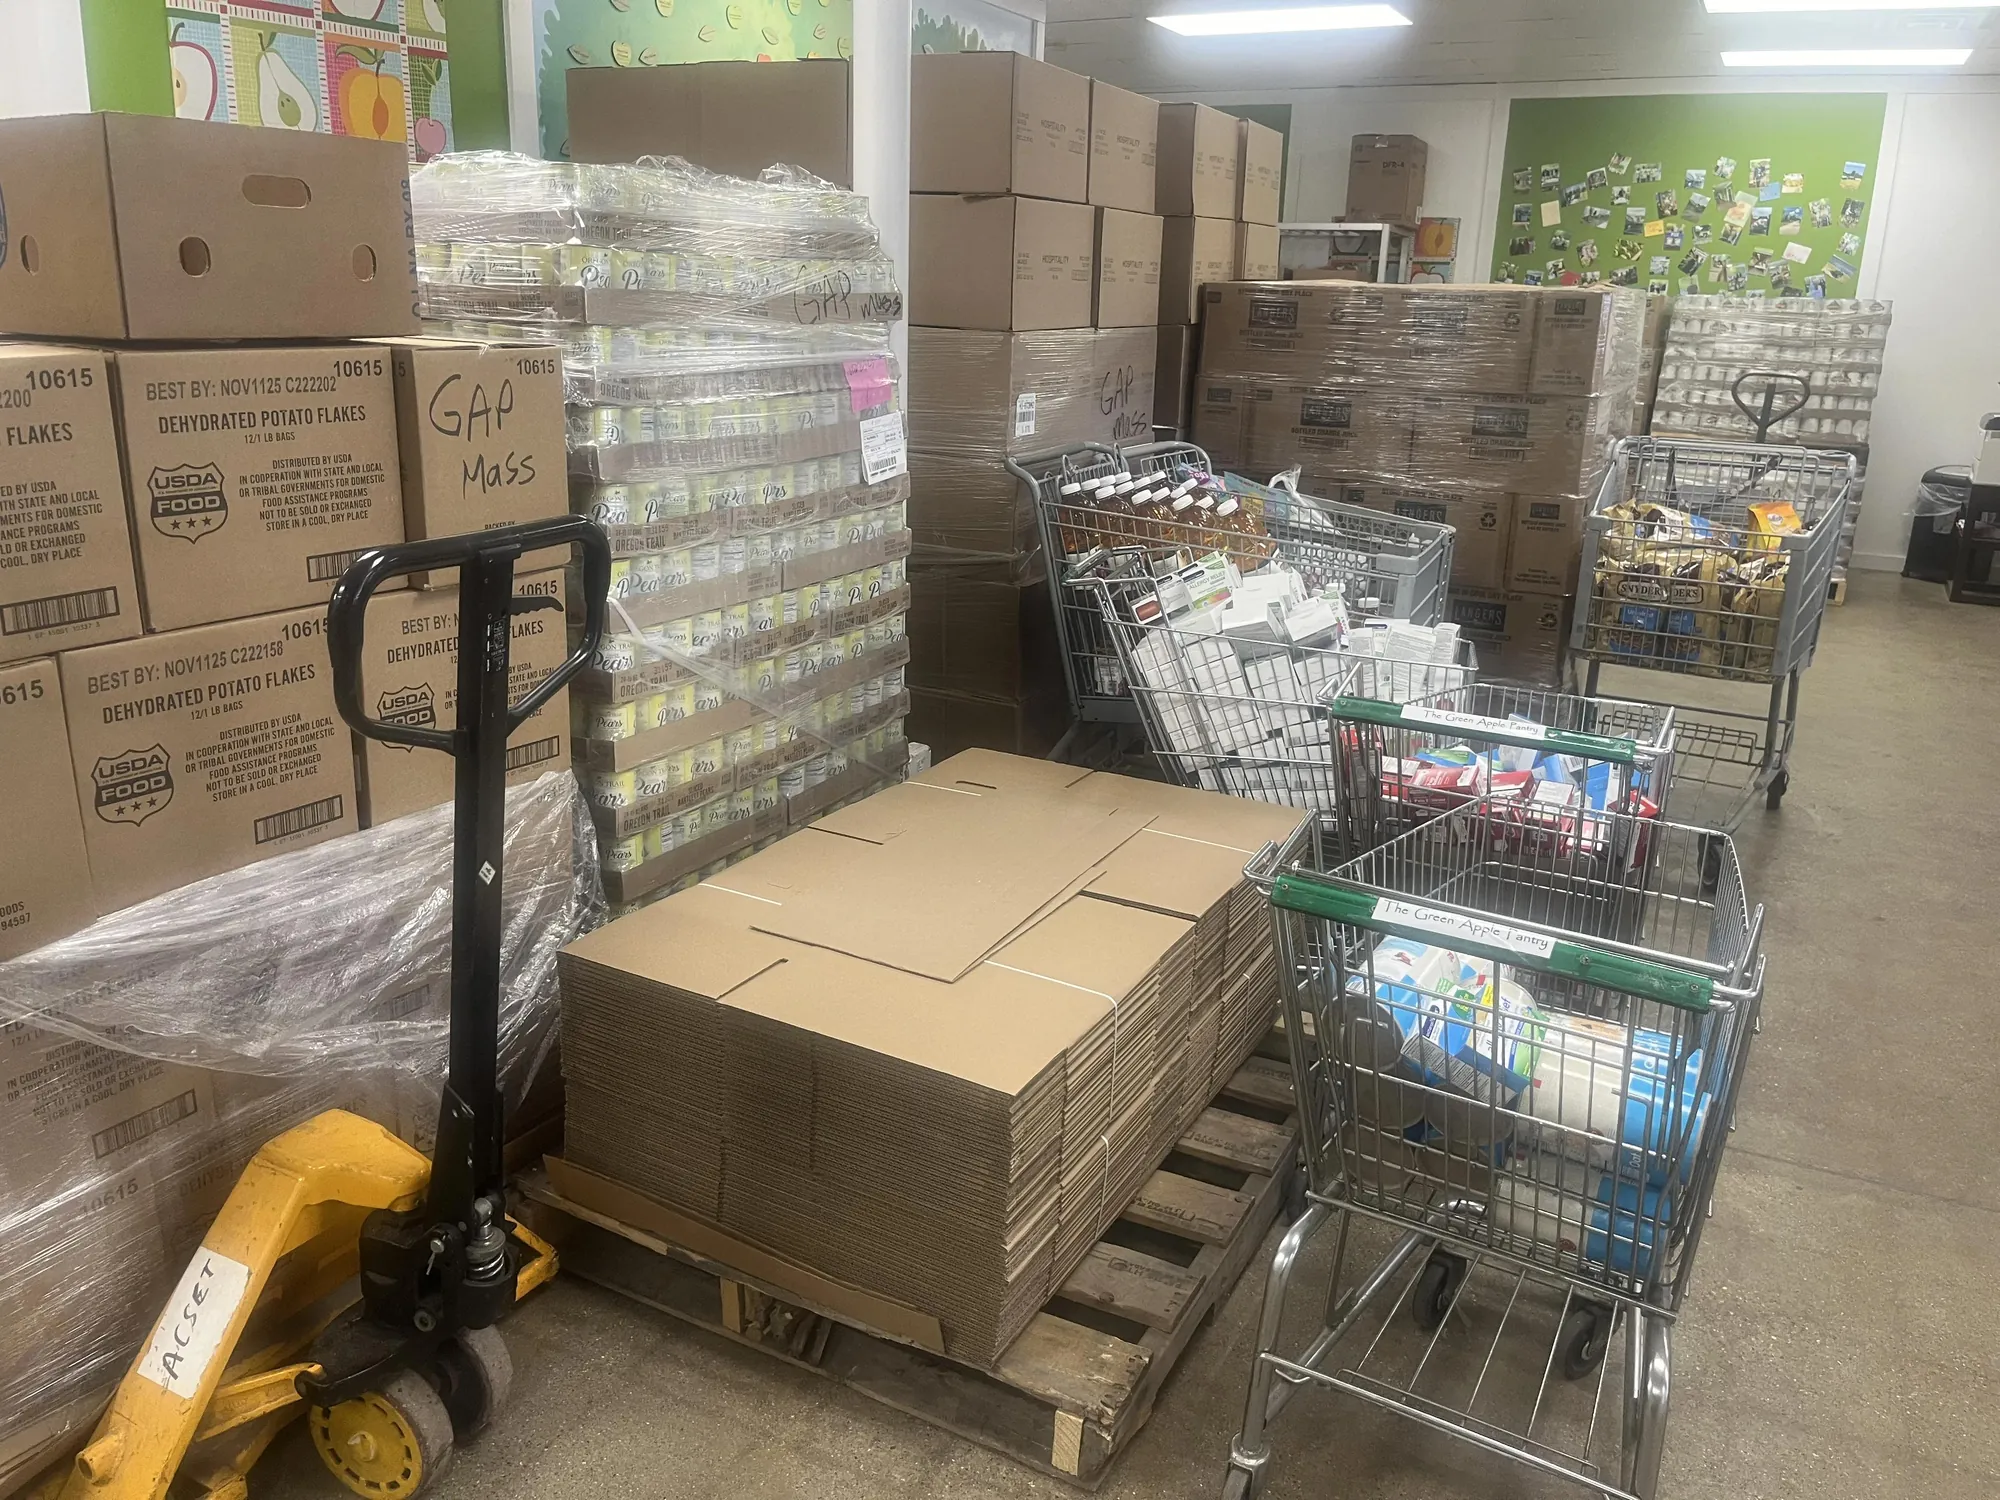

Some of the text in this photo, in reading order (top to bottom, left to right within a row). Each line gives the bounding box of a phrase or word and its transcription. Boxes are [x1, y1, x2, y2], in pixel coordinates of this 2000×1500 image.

[794, 264, 851, 324] GAP
[334, 360, 382, 378] 10615
[516, 359, 554, 375] 10615
[26, 368, 93, 390] 10615
[146, 376, 336, 400] BEST BY: NOV1125 C222202
[0, 389, 31, 408] 200
[1101, 365, 1134, 416] GAP
[429, 374, 514, 442] GAP
[158, 405, 366, 434] DEHYDRATED POTATO FLAKES
[6, 422, 73, 446] FLAKES
[244, 432, 296, 444] 12/1 LB BAGS
[272, 454, 352, 470] DISTRIBUTED BY USDA
[154, 472, 218, 490] USDA
[240, 462, 384, 484] IN COOPERATION WITH STATE AND LOCAL
[16, 484, 28, 494] BY
[31, 481, 57, 493] USDA
[239, 474, 385, 498] OR TRIBAL GOVERNMENTS FOR DOMESTIC
[18, 496, 46, 510] STATE
[50, 493, 68, 504] AND
[72, 490, 100, 502] LOCAL
[157, 495, 220, 514] FOOD
[262, 488, 368, 508] FOOD ASSISTANCE PROGRAMS
[36, 510, 54, 522] FOR
[56, 504, 102, 518] DOMESTIC
[260, 499, 372, 520] NOT TO BE SOLD OR EXCHANGED
[28, 520, 80, 536] PROGRAMS
[266, 510, 368, 532] STORE IN A COOL, DRY PLACE
[15, 542, 28, 552] OR
[30, 533, 86, 550] EXCHANGED
[31, 552, 49, 564] DRY
[52, 547, 82, 560] PLACE
[518, 580, 558, 595] 10615
[1621, 584, 1662, 597] SNYDER
[402, 614, 451, 635] BEST BY:
[1454, 606, 1502, 625] LANGERS
[388, 620, 544, 664] DEHYDRATED LAKES
[88, 640, 283, 694] BEST BY: NOV1125 C222158
[517, 662, 532, 672] USDA
[592, 650, 632, 671] Pears
[509, 670, 538, 684] STATE AND
[0, 679, 44, 704] 615
[103, 664, 316, 724] DEHYDRATED POTATO FLAKES
[382, 692, 430, 710] USDA
[191, 701, 243, 720] 12/1 LB BAGS
[385, 710, 430, 724] OOD
[220, 714, 302, 740] DISTRIBUTED BY USDA
[596, 716, 622, 728] Pears
[1424, 710, 1538, 734] The Green Apple Pantry
[186, 717, 333, 762] IN COOPERATION WITH STATE AND LOCAL
[185, 728, 335, 774] OR TRIBAL GOVERNMENTS FOR DOMESTIC
[98, 754, 164, 778] USDA
[206, 753, 322, 792] NOT TO BE SOLD OR EXCHANGED
[209, 744, 318, 780] FOOD ASSISTANCE PROGRAMS
[101, 776, 166, 802] FOOD
[212, 788, 237, 802] STORE
[240, 784, 248, 794] IN
[250, 782, 254, 792] A
[280, 772, 294, 784] DRY
[296, 765, 318, 778] PLACE
[624, 806, 670, 832] OREGON TRAIL
[605, 848, 632, 860] Pears
[1384, 900, 1408, 915] The
[1414, 908, 1454, 924] Green
[1458, 919, 1500, 938] Apple
[162, 1258, 214, 1380] ACSET
